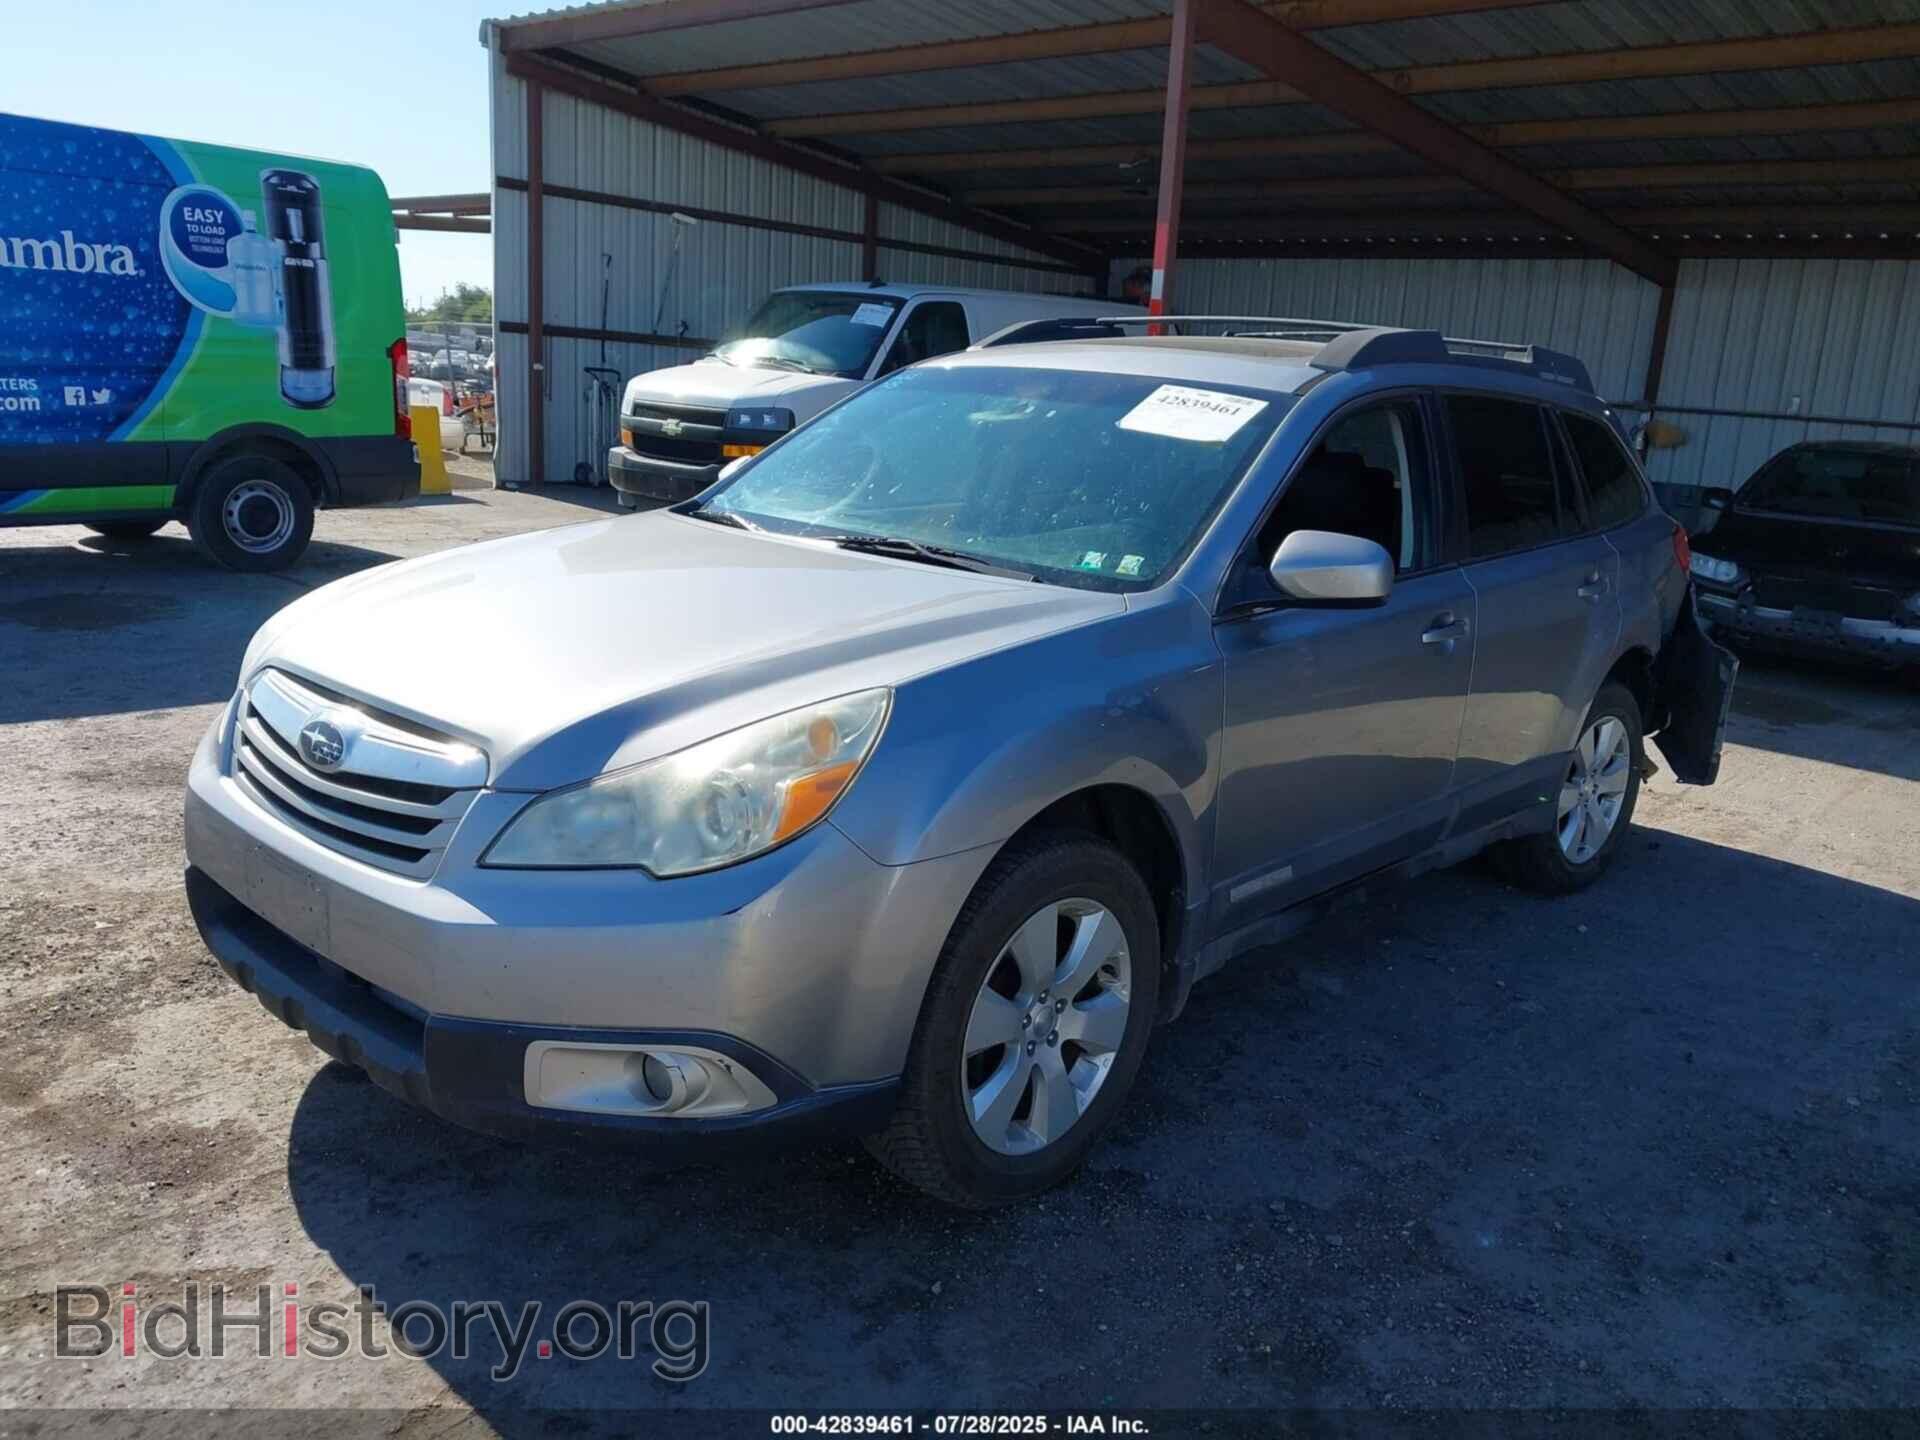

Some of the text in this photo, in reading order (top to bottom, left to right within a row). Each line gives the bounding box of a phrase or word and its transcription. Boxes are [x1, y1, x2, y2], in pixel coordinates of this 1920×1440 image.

[183, 207, 224, 224] EASY
[187, 224, 226, 236] TO LOAD
[1157, 395, 1241, 416] 42839461
